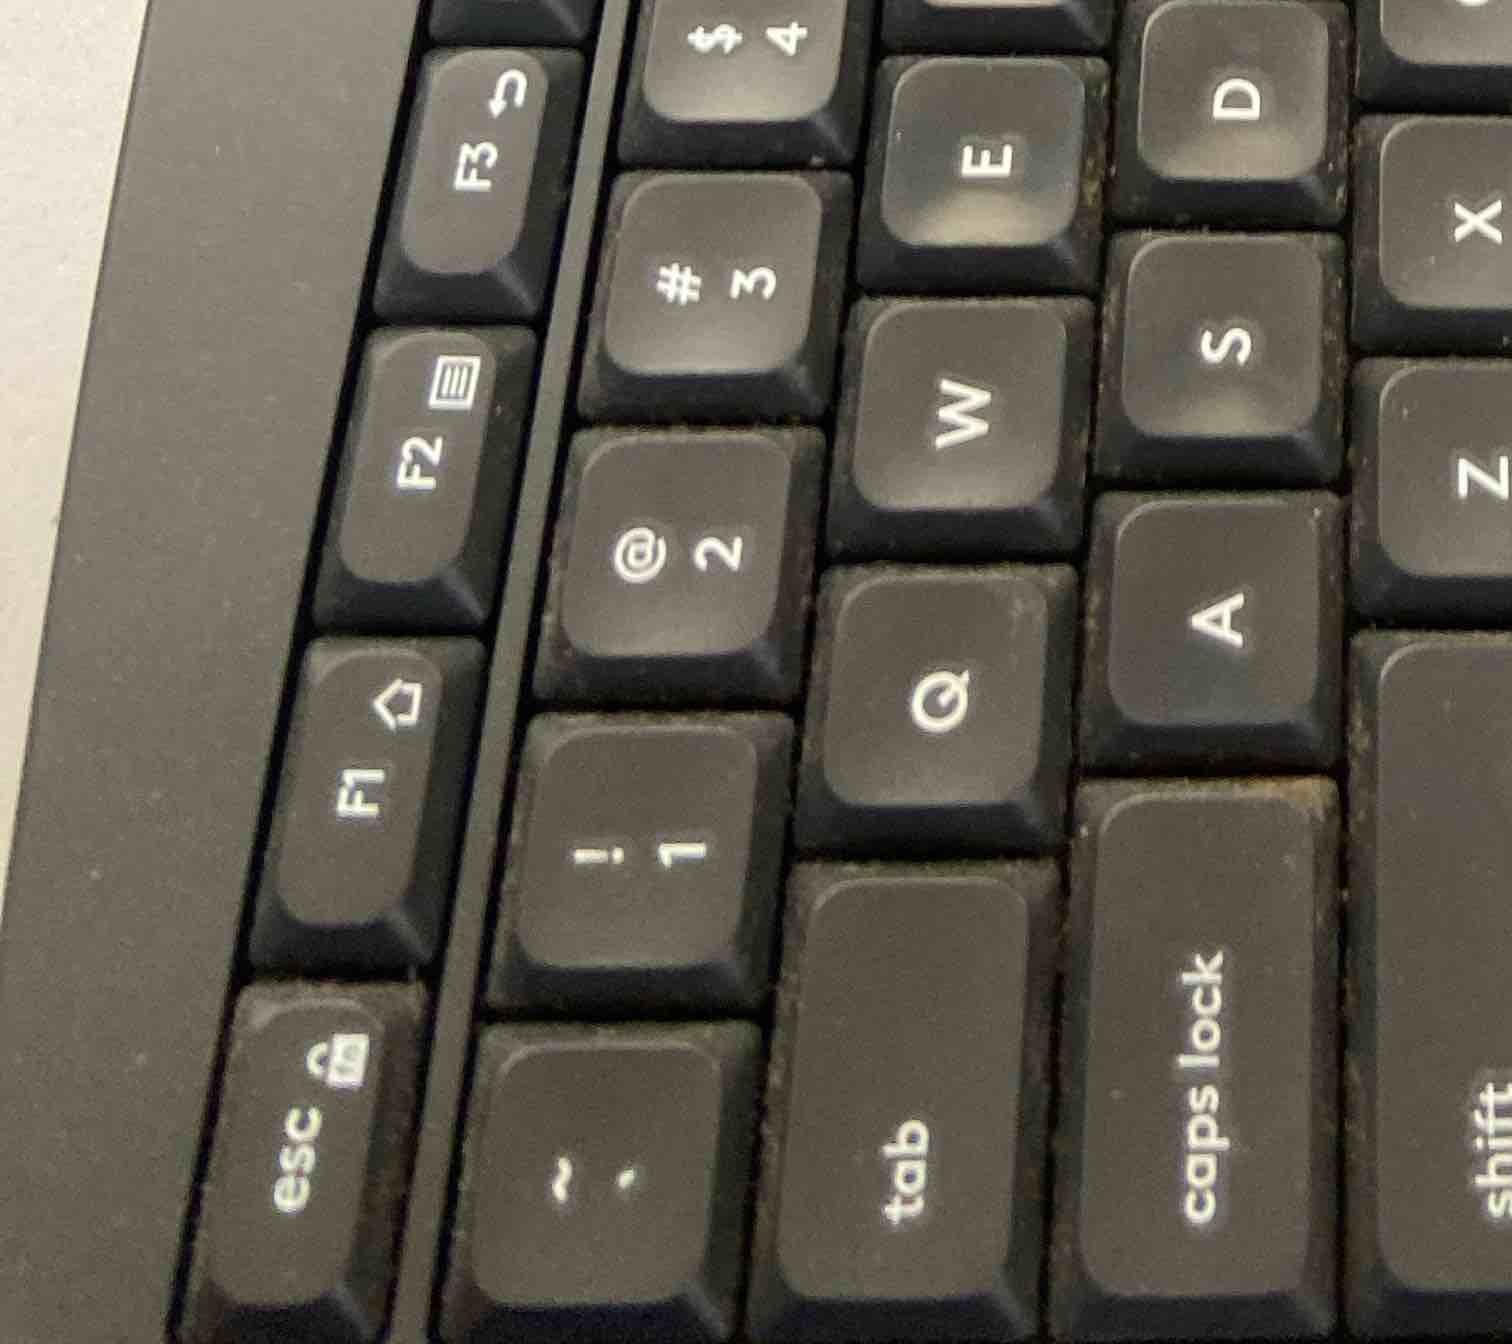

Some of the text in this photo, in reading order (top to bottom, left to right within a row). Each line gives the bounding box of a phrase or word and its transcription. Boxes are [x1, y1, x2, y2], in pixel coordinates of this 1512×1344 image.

[687, 23, 743, 53] $
[765, 21, 808, 56] 4
[1212, 78, 1261, 121] D
[453, 141, 498, 191] F3
[961, 144, 1013, 177] E
[1454, 199, 1503, 244] X
[656, 262, 702, 305] #
[730, 266, 777, 299] 3
[1200, 327, 1252, 365] S
[935, 379, 992, 449] W
[396, 436, 443, 490] F2
[1457, 455, 1510, 500] Z
[613, 527, 667, 583] @
[693, 536, 743, 571] 2
[1191, 593, 1245, 647] A
[911, 670, 970, 733] Q
[335, 769, 385, 818] F1
[573, 847, 625, 864] !
[657, 842, 707, 868] 1
[1177, 951, 1230, 1225] caps lock
[273, 1107, 322, 1213] esc
[551, 1157, 572, 1202] ~
[882, 1119, 930, 1225] tab
